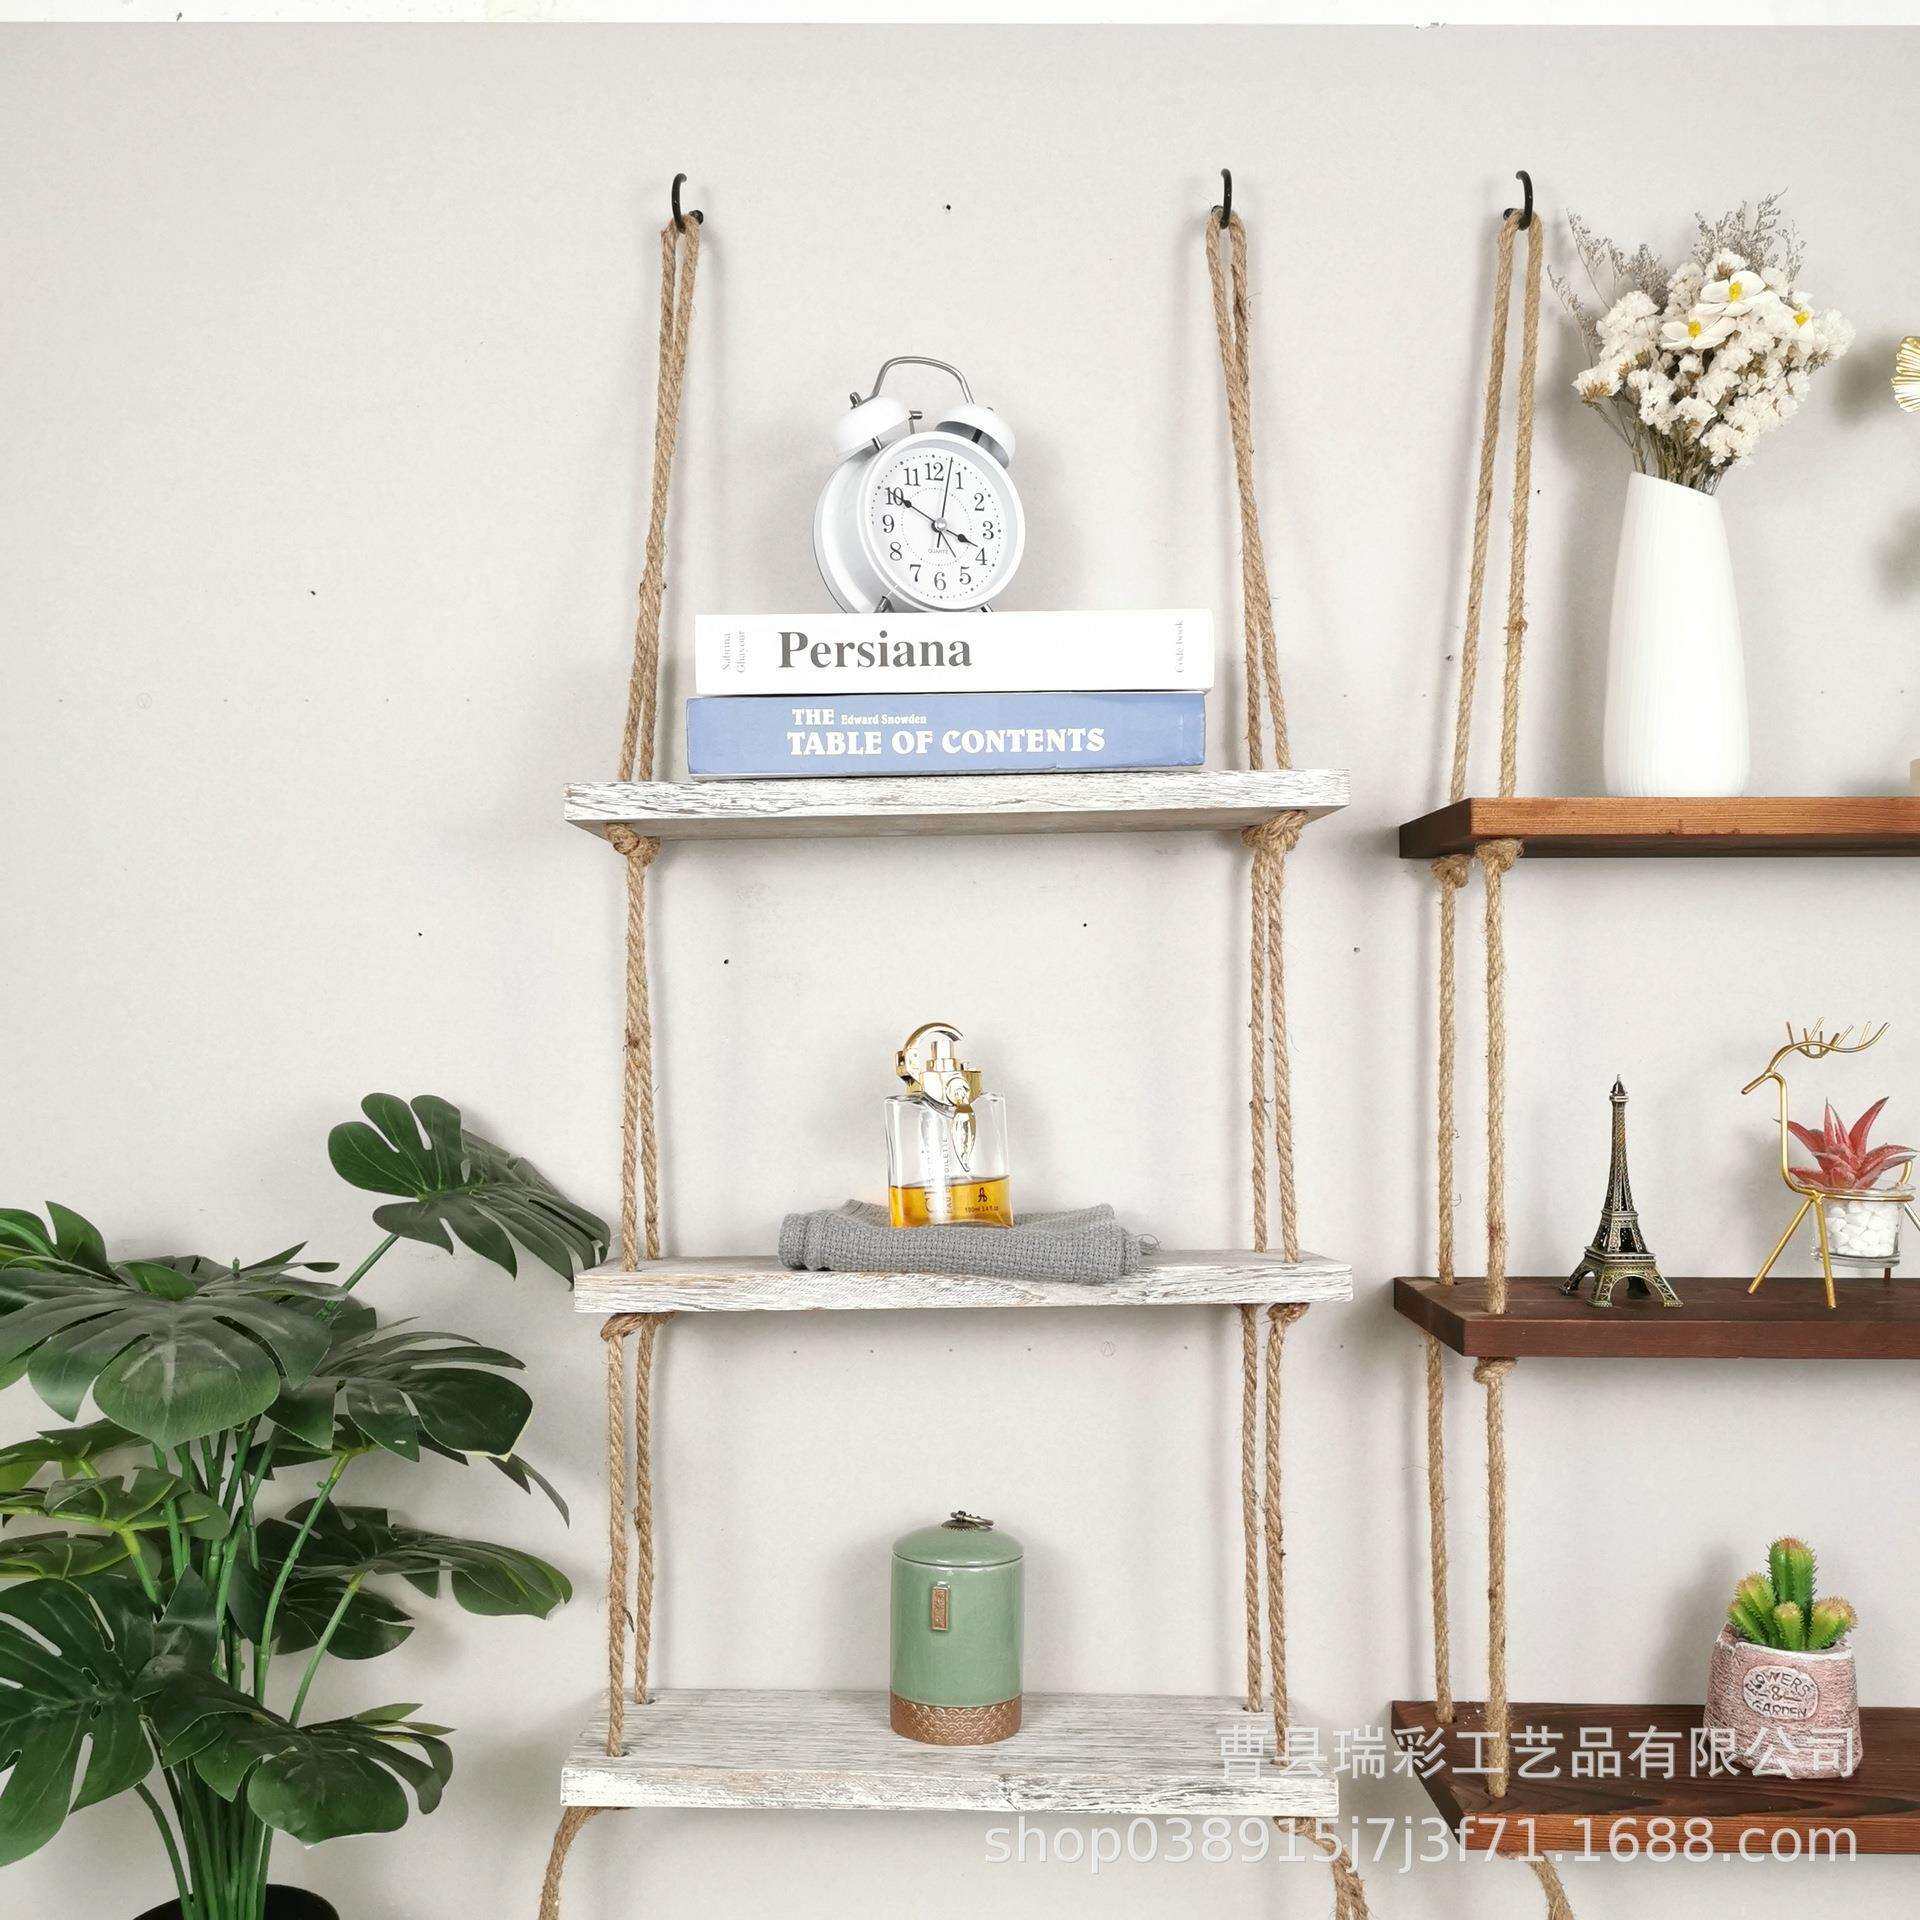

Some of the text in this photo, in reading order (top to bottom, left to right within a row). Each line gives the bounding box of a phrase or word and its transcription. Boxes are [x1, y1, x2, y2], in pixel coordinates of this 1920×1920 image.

[903, 467, 921, 487] 11
[925, 462, 944, 481] 12
[955, 471, 964, 490] 1
[885, 486, 905, 506] 10
[973, 492, 985, 512] 2
[882, 514, 895, 533] 9
[982, 520, 994, 540] 3
[889, 541, 903, 561] 8
[975, 547, 988, 566] 4
[909, 564, 921, 583] 7
[934, 571, 947, 591] 6
[959, 566, 972, 585] 5
[777, 629, 973, 669] Persiana
[791, 708, 927, 726] THE Edward Snowden
[787, 728, 1105, 756] TABLE OF CONTENTS
[1744, 1671, 1815, 1697] FLOWERS
[1751, 1701, 1807, 1718] GARDEN
